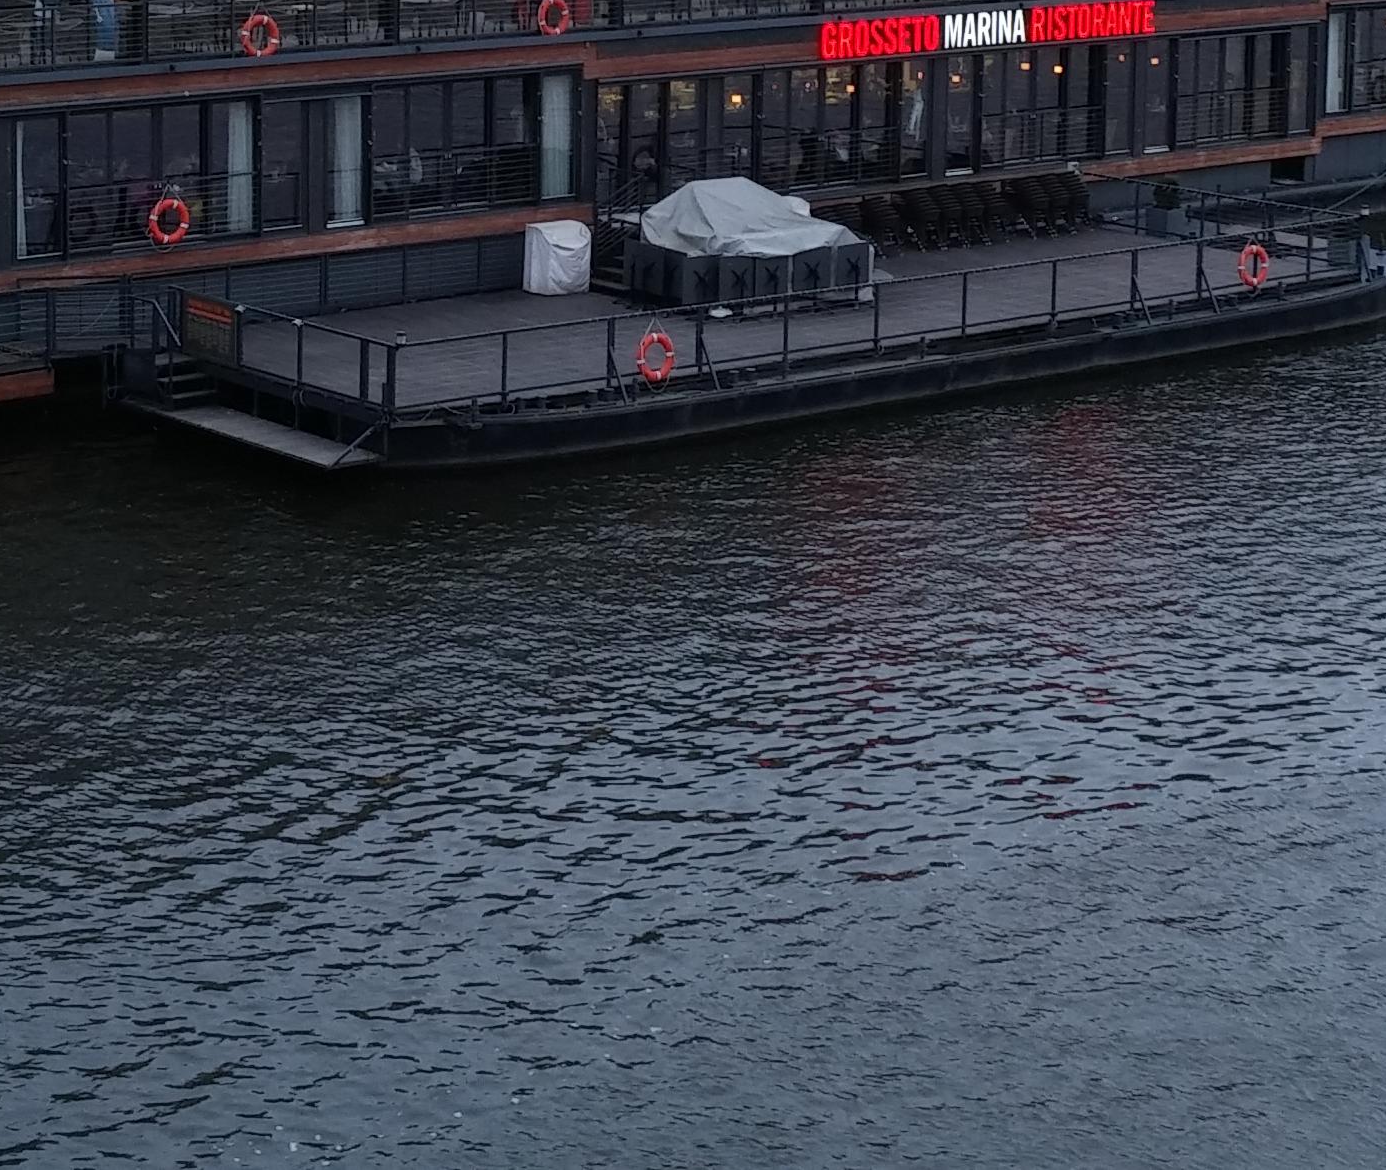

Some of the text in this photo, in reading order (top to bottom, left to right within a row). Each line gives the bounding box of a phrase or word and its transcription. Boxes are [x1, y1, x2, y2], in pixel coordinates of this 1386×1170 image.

[821, 0, 1156, 59] GROSSETO MARINA RISTORANTE
